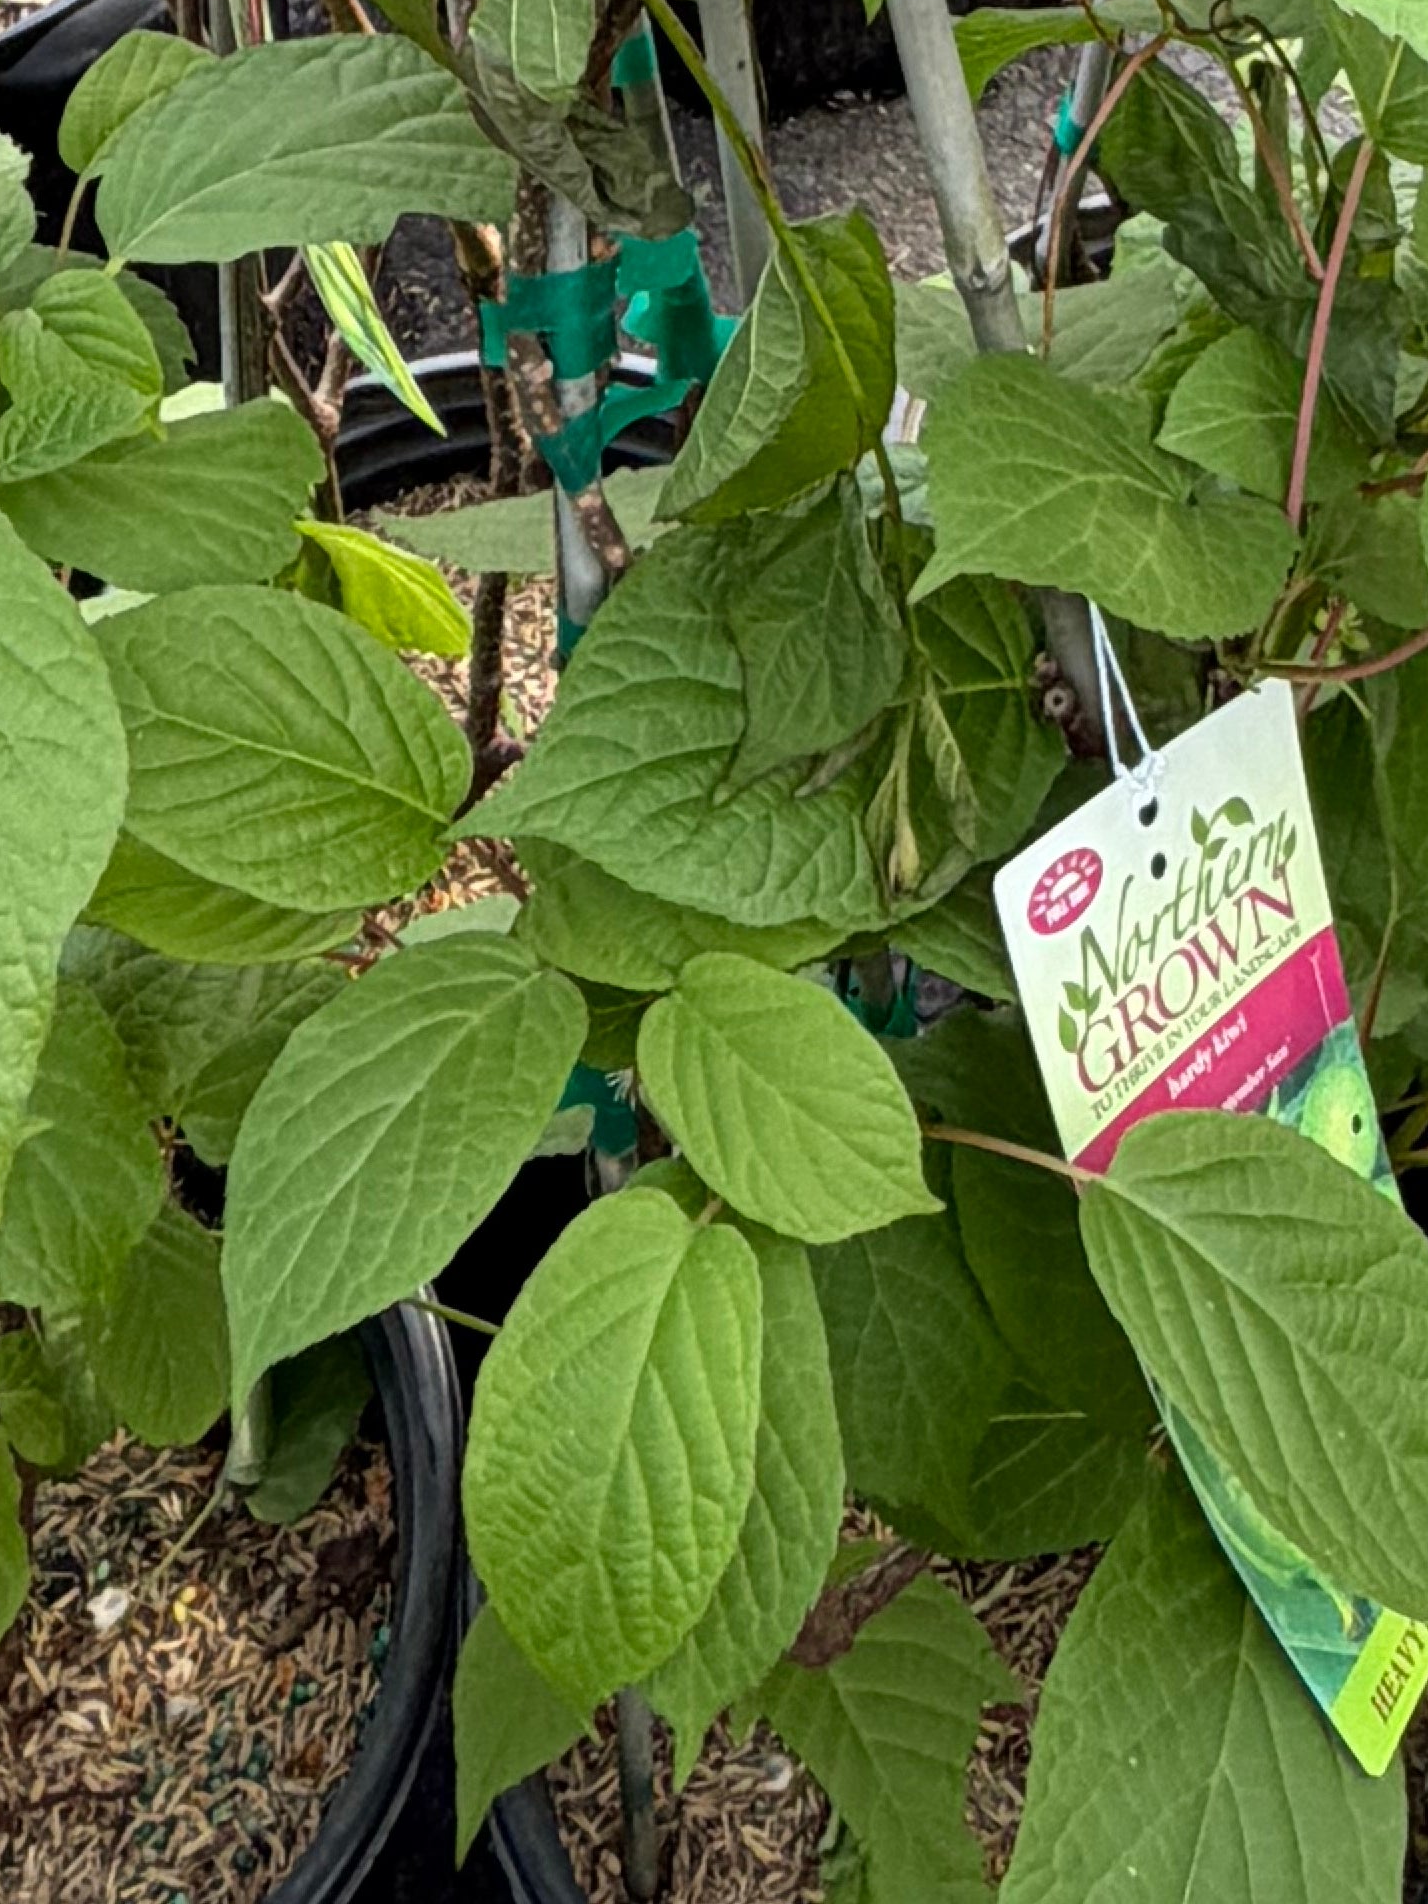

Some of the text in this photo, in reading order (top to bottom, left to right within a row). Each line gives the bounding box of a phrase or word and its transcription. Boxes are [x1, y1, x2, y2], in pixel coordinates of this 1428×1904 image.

[1076, 863, 1296, 1093] GROWN
[1082, 809, 1289, 998] Northern
[1371, 1620, 1426, 1724] HEAVY
